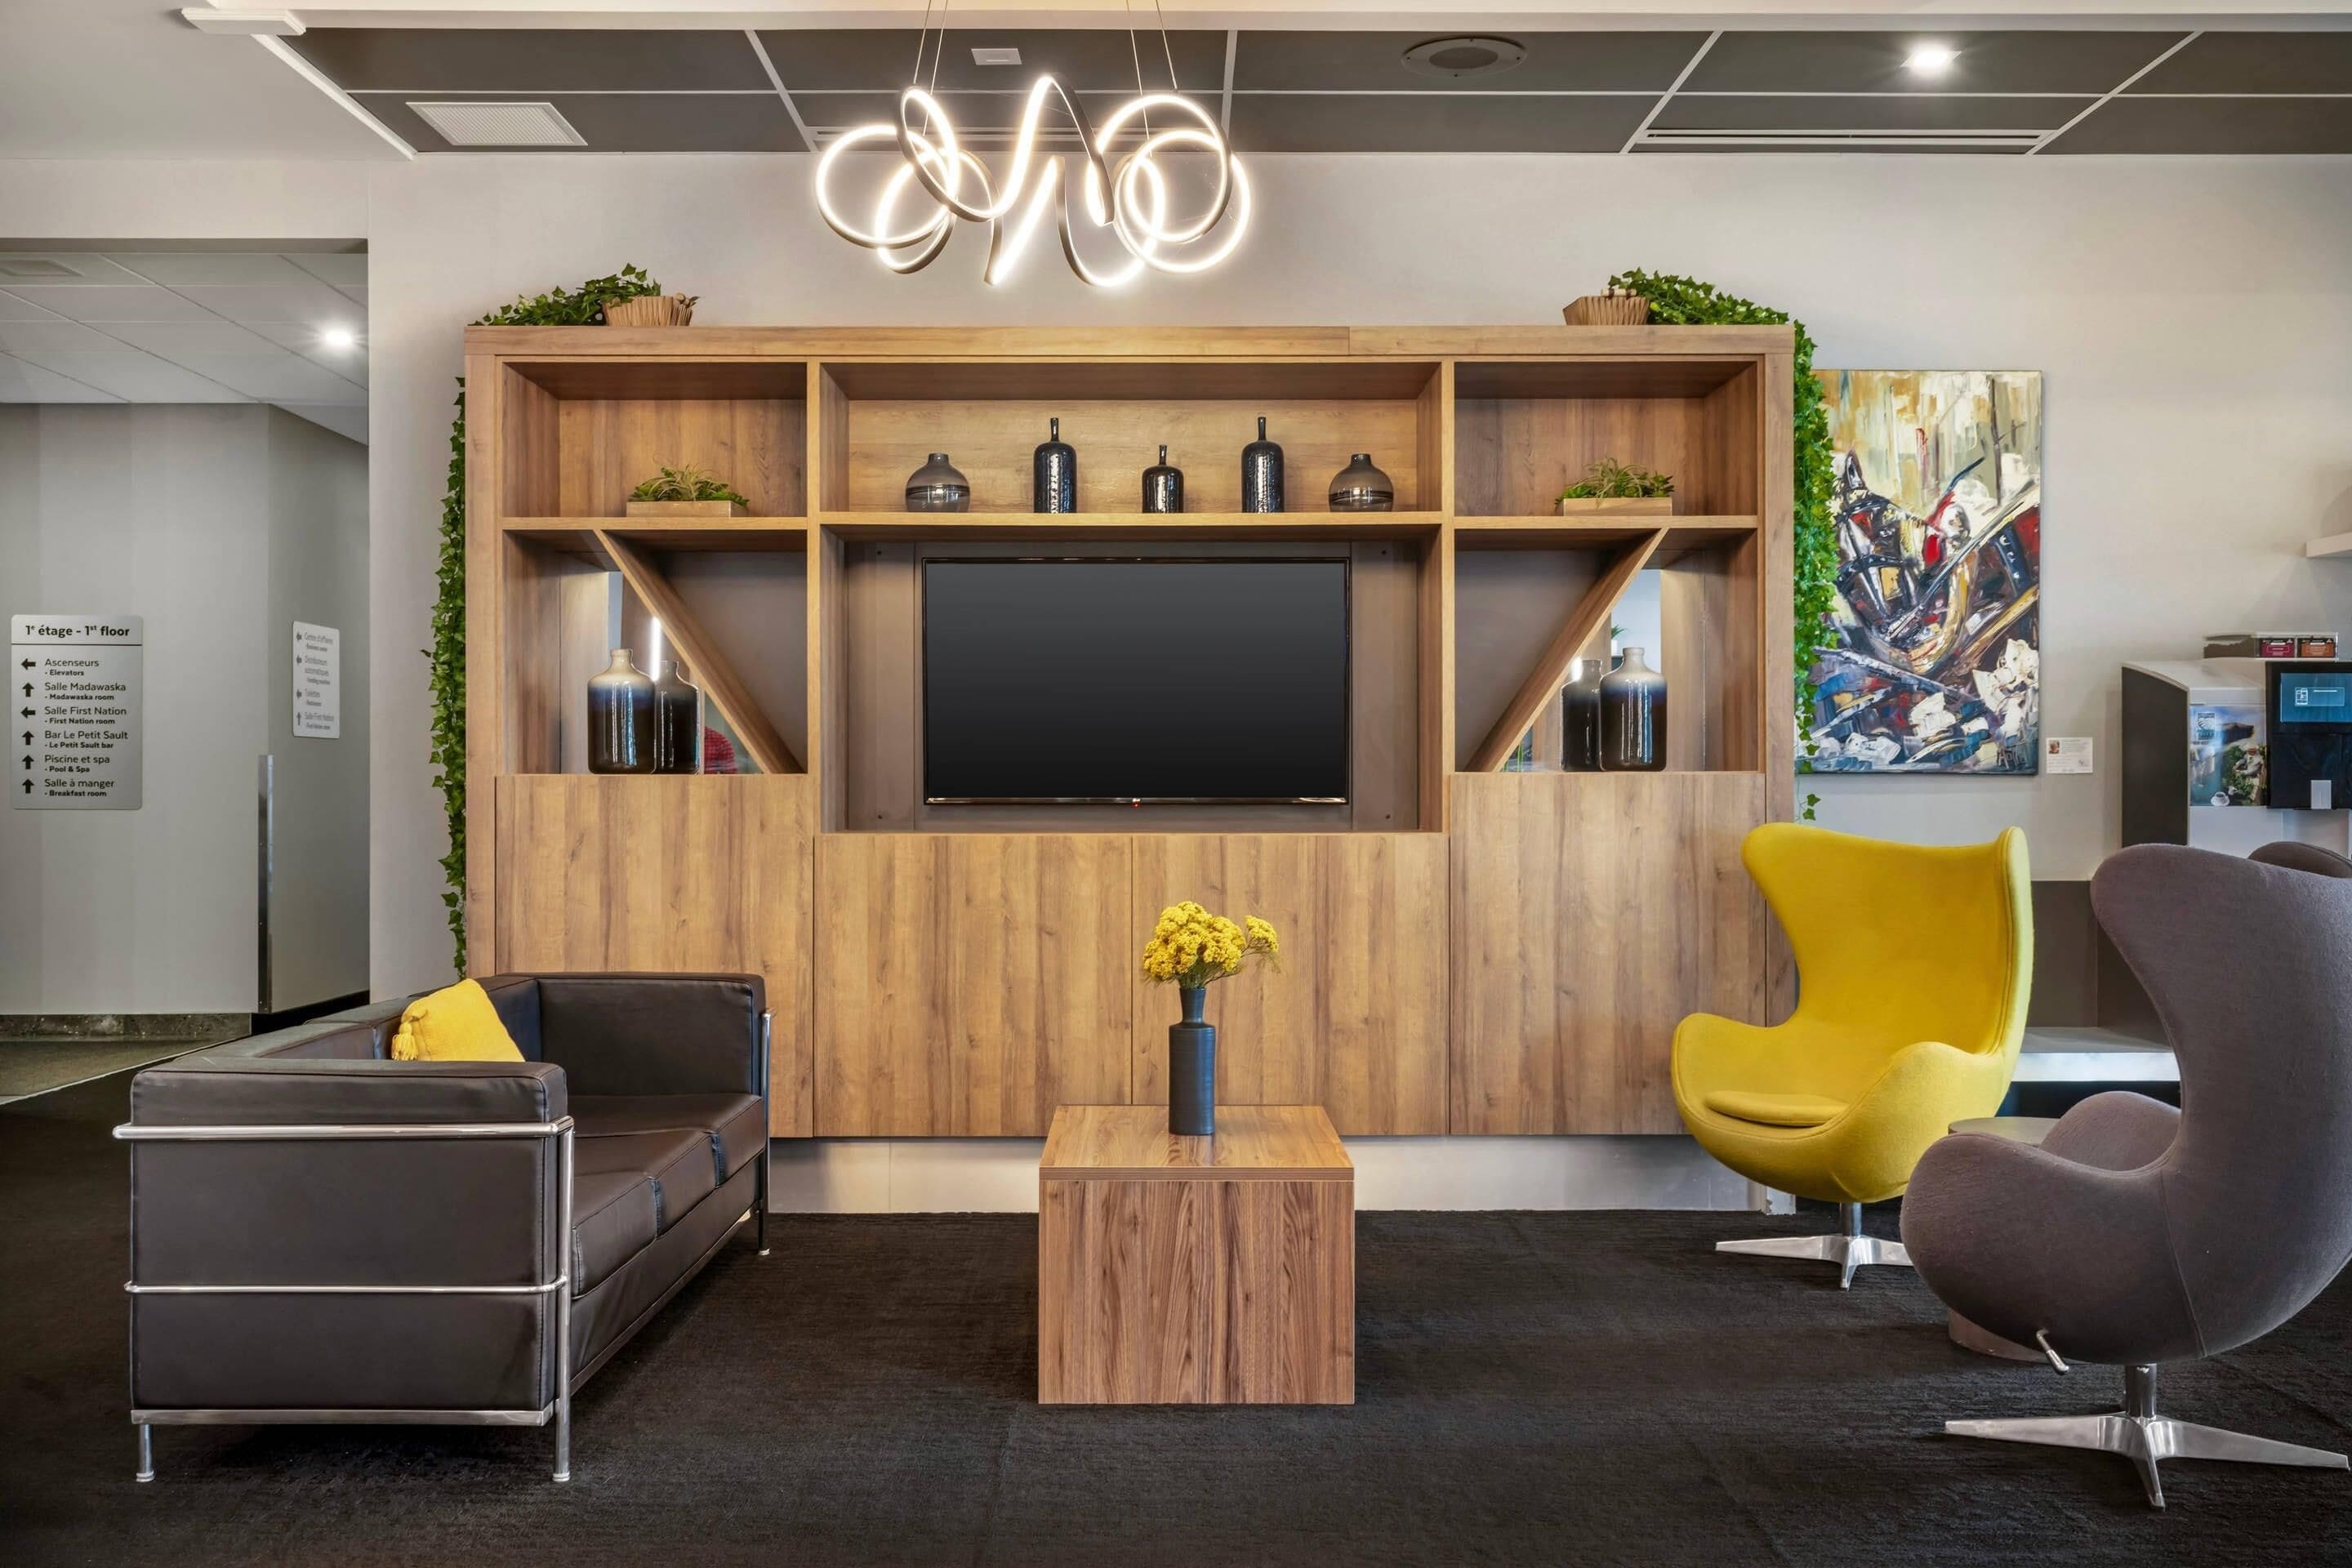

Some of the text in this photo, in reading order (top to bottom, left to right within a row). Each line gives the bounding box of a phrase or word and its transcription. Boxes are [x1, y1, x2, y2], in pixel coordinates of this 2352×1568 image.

[38, 625, 73, 638] étage
[100, 626, 130, 636] floor
[45, 658, 99, 667] Ascenseurs
[45, 682, 126, 691] Salle Madawaska
[45, 706, 127, 715] Salle First Nation
[64, 731, 75, 739] Le
[78, 731, 100, 739] Petit
[104, 731, 128, 739] Sault
[45, 755, 78, 763] Piscine
[45, 779, 67, 787] Salle
[78, 781, 114, 789] manger
